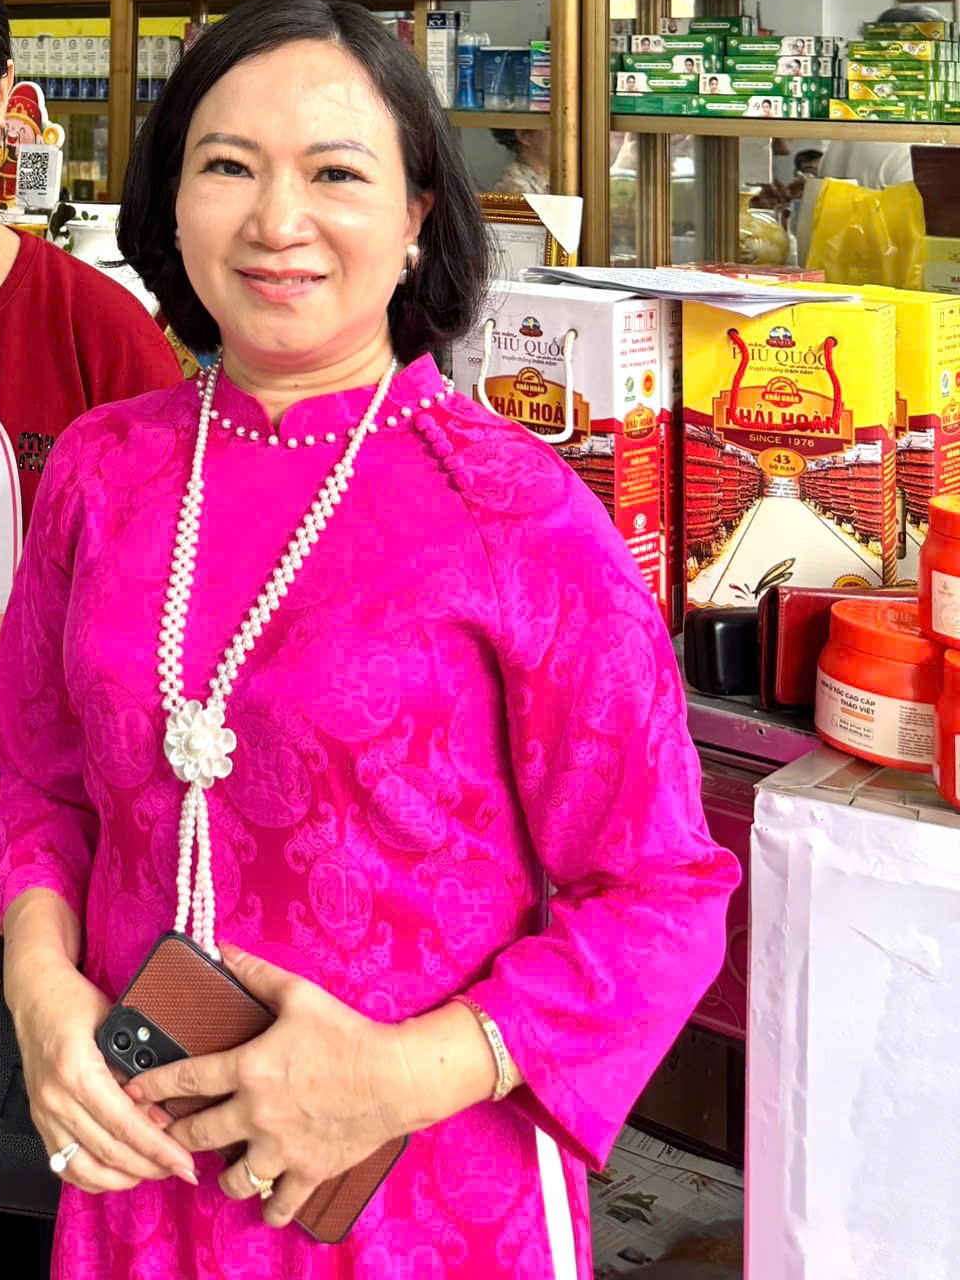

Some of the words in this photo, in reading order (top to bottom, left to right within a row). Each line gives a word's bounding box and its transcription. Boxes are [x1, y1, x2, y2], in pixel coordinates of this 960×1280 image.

[749, 433, 782, 444] SINCE
[788, 437, 815, 448] 1976
[773, 454, 791, 465] 43
[845, 692, 859, 702] CAO
